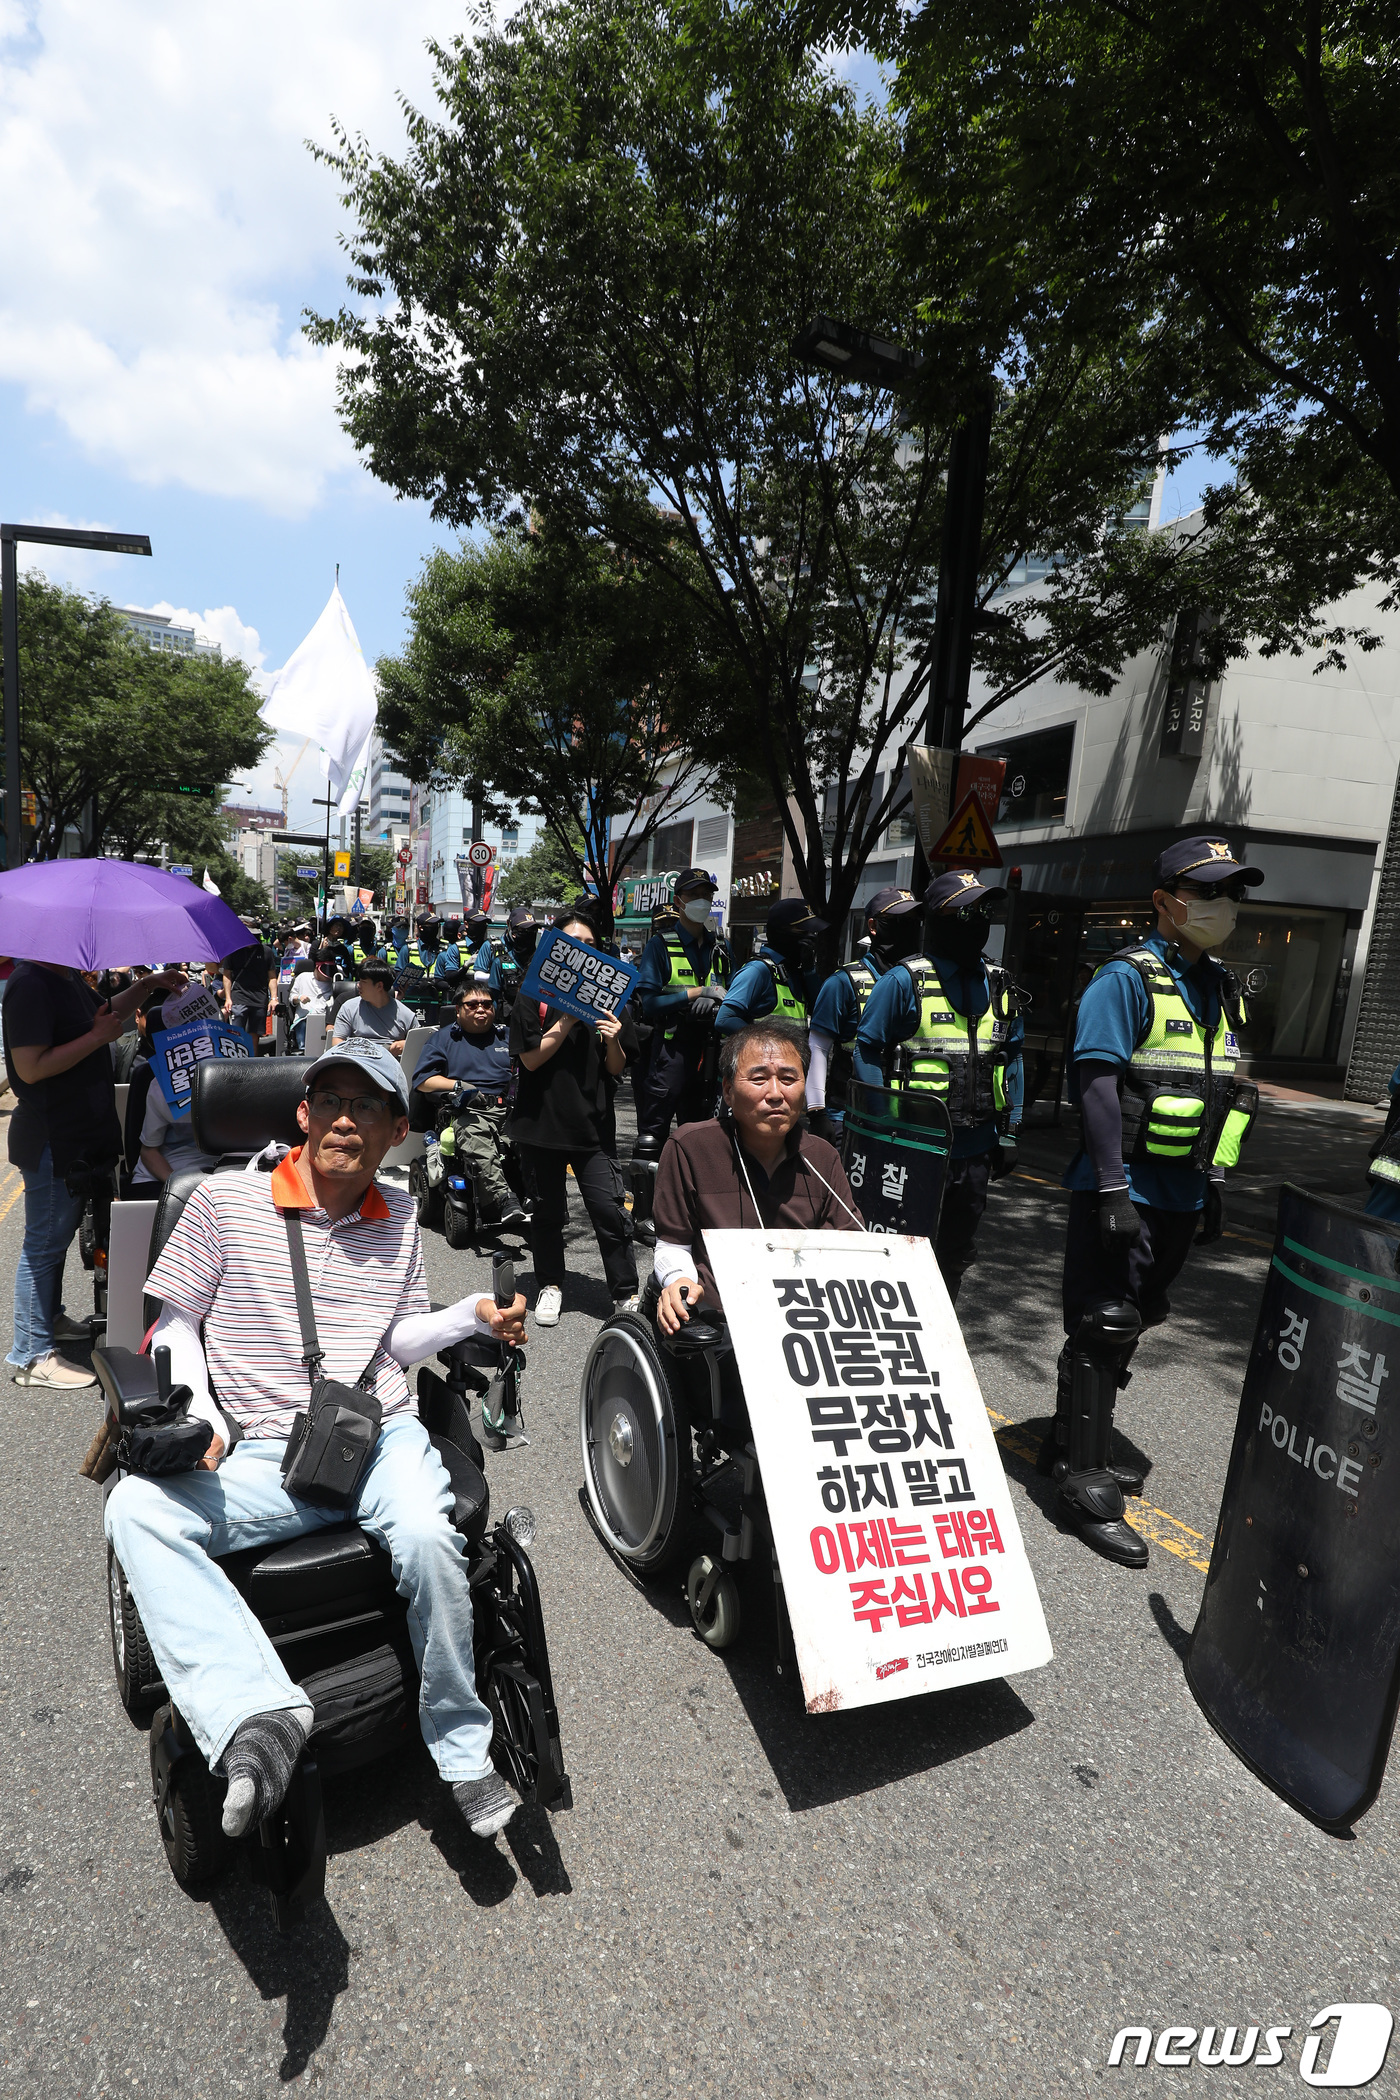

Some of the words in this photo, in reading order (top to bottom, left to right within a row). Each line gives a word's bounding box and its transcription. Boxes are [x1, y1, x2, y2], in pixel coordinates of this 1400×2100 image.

[474, 849, 487, 860] 30
[538, 959, 579, 994] 탄압
[549, 938, 631, 996] 장애인운동
[165, 1036, 215, 1071] 중단!
[772, 1278, 923, 1331] 장애인
[781, 1330, 941, 1388] 이동권,
[805, 1391, 956, 1458] 무정차
[1258, 1402, 1364, 1498] POLICE
[816, 1461, 899, 1514] 하지
[901, 1456, 977, 1508] 말고
[809, 1514, 932, 1575] 이제는
[934, 1507, 1006, 1558] 태워
[846, 1564, 1002, 1634] 주십시오
[915, 1637, 1009, 1669] 전국장애인차별철폐연대
